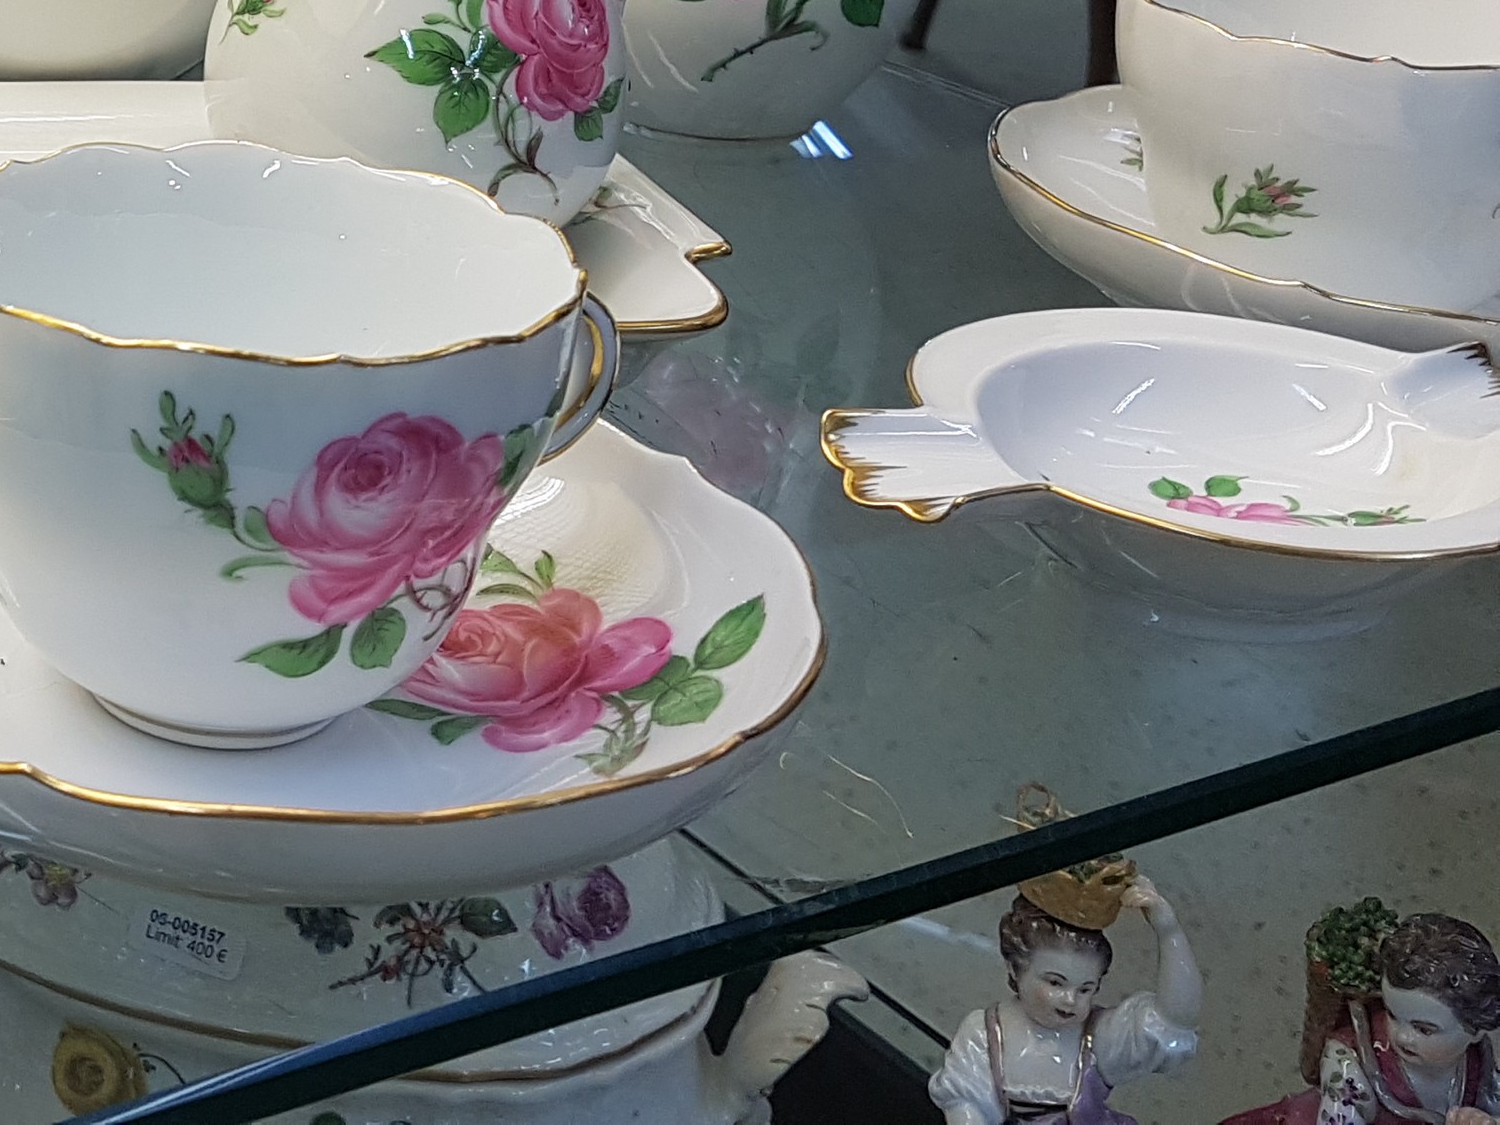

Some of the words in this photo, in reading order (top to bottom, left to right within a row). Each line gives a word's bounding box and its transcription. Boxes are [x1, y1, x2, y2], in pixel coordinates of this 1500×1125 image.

[145, 925, 182, 948] Limit
[186, 939, 214, 958] 400
[217, 949, 228, 963] €
